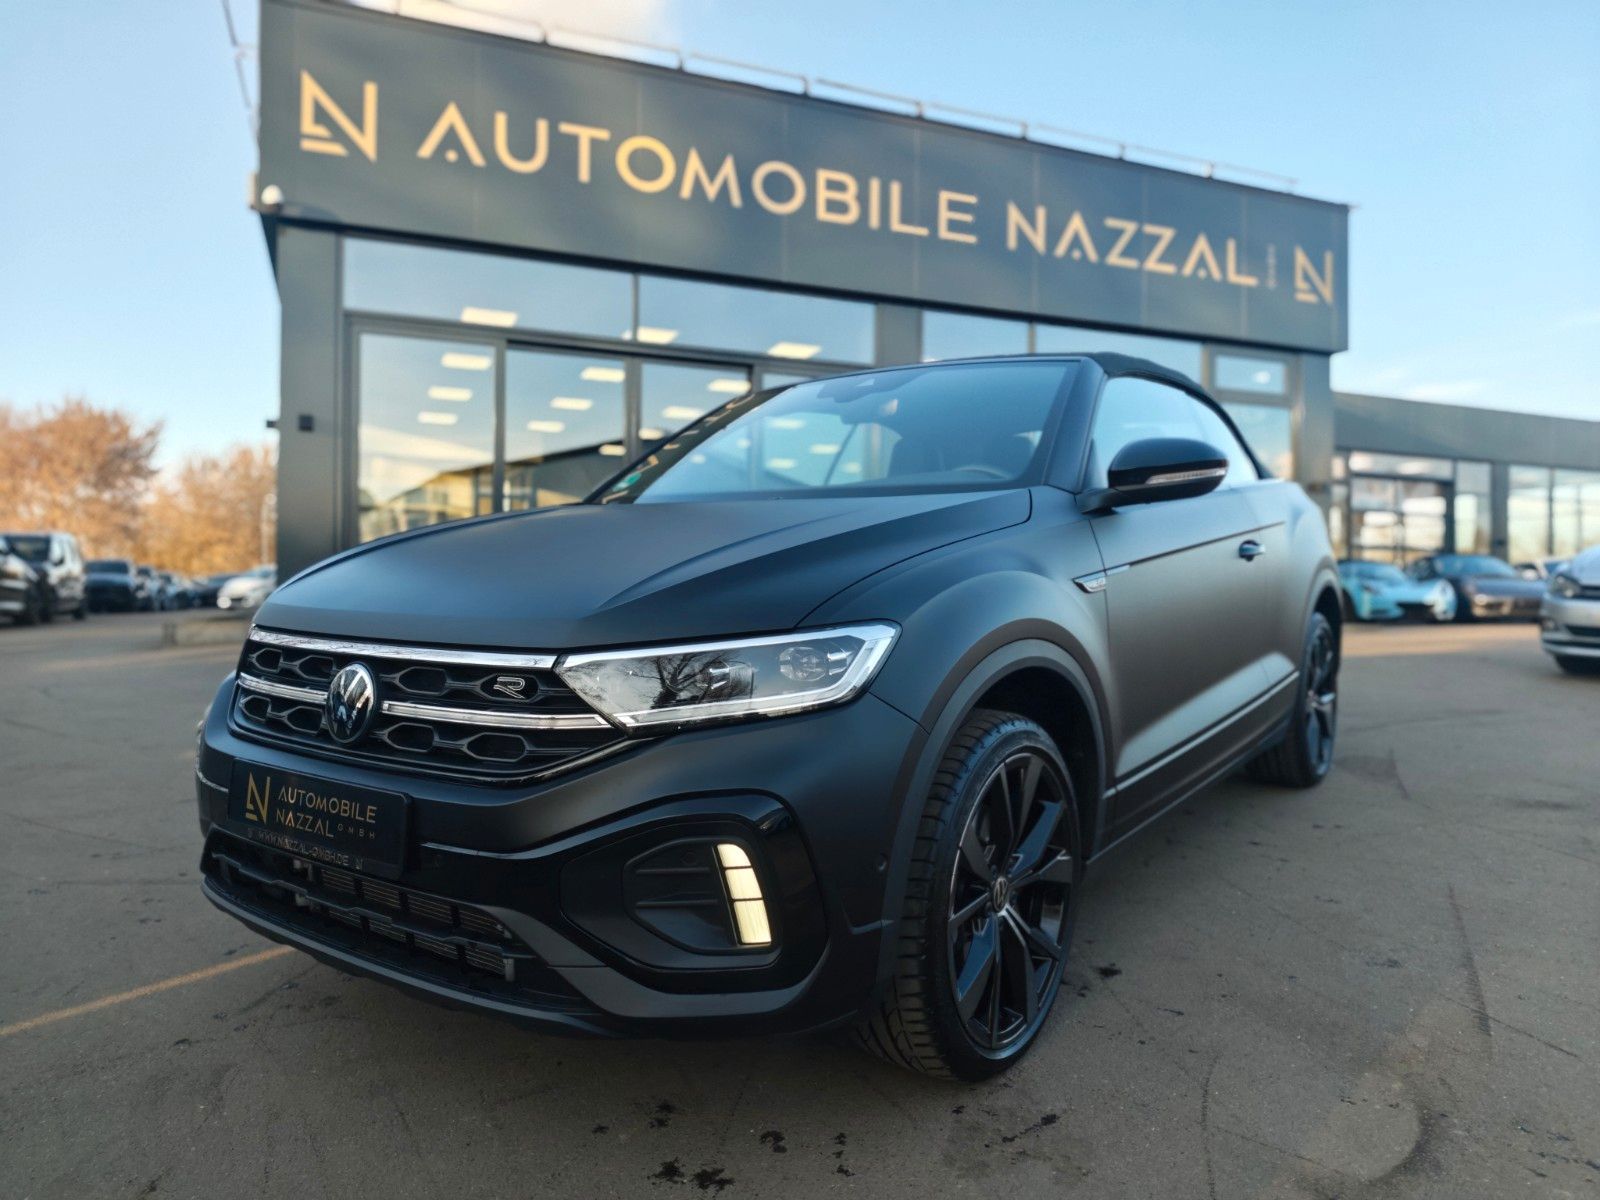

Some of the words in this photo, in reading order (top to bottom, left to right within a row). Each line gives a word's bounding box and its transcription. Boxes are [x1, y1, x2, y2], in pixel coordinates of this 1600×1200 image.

[416, 101, 979, 245] AUTOMOBILE
[1006, 200, 1259, 288] NAZZAL
[278, 786, 377, 822] AUTOMOBILE
[276, 808, 334, 837] NAZZAL
